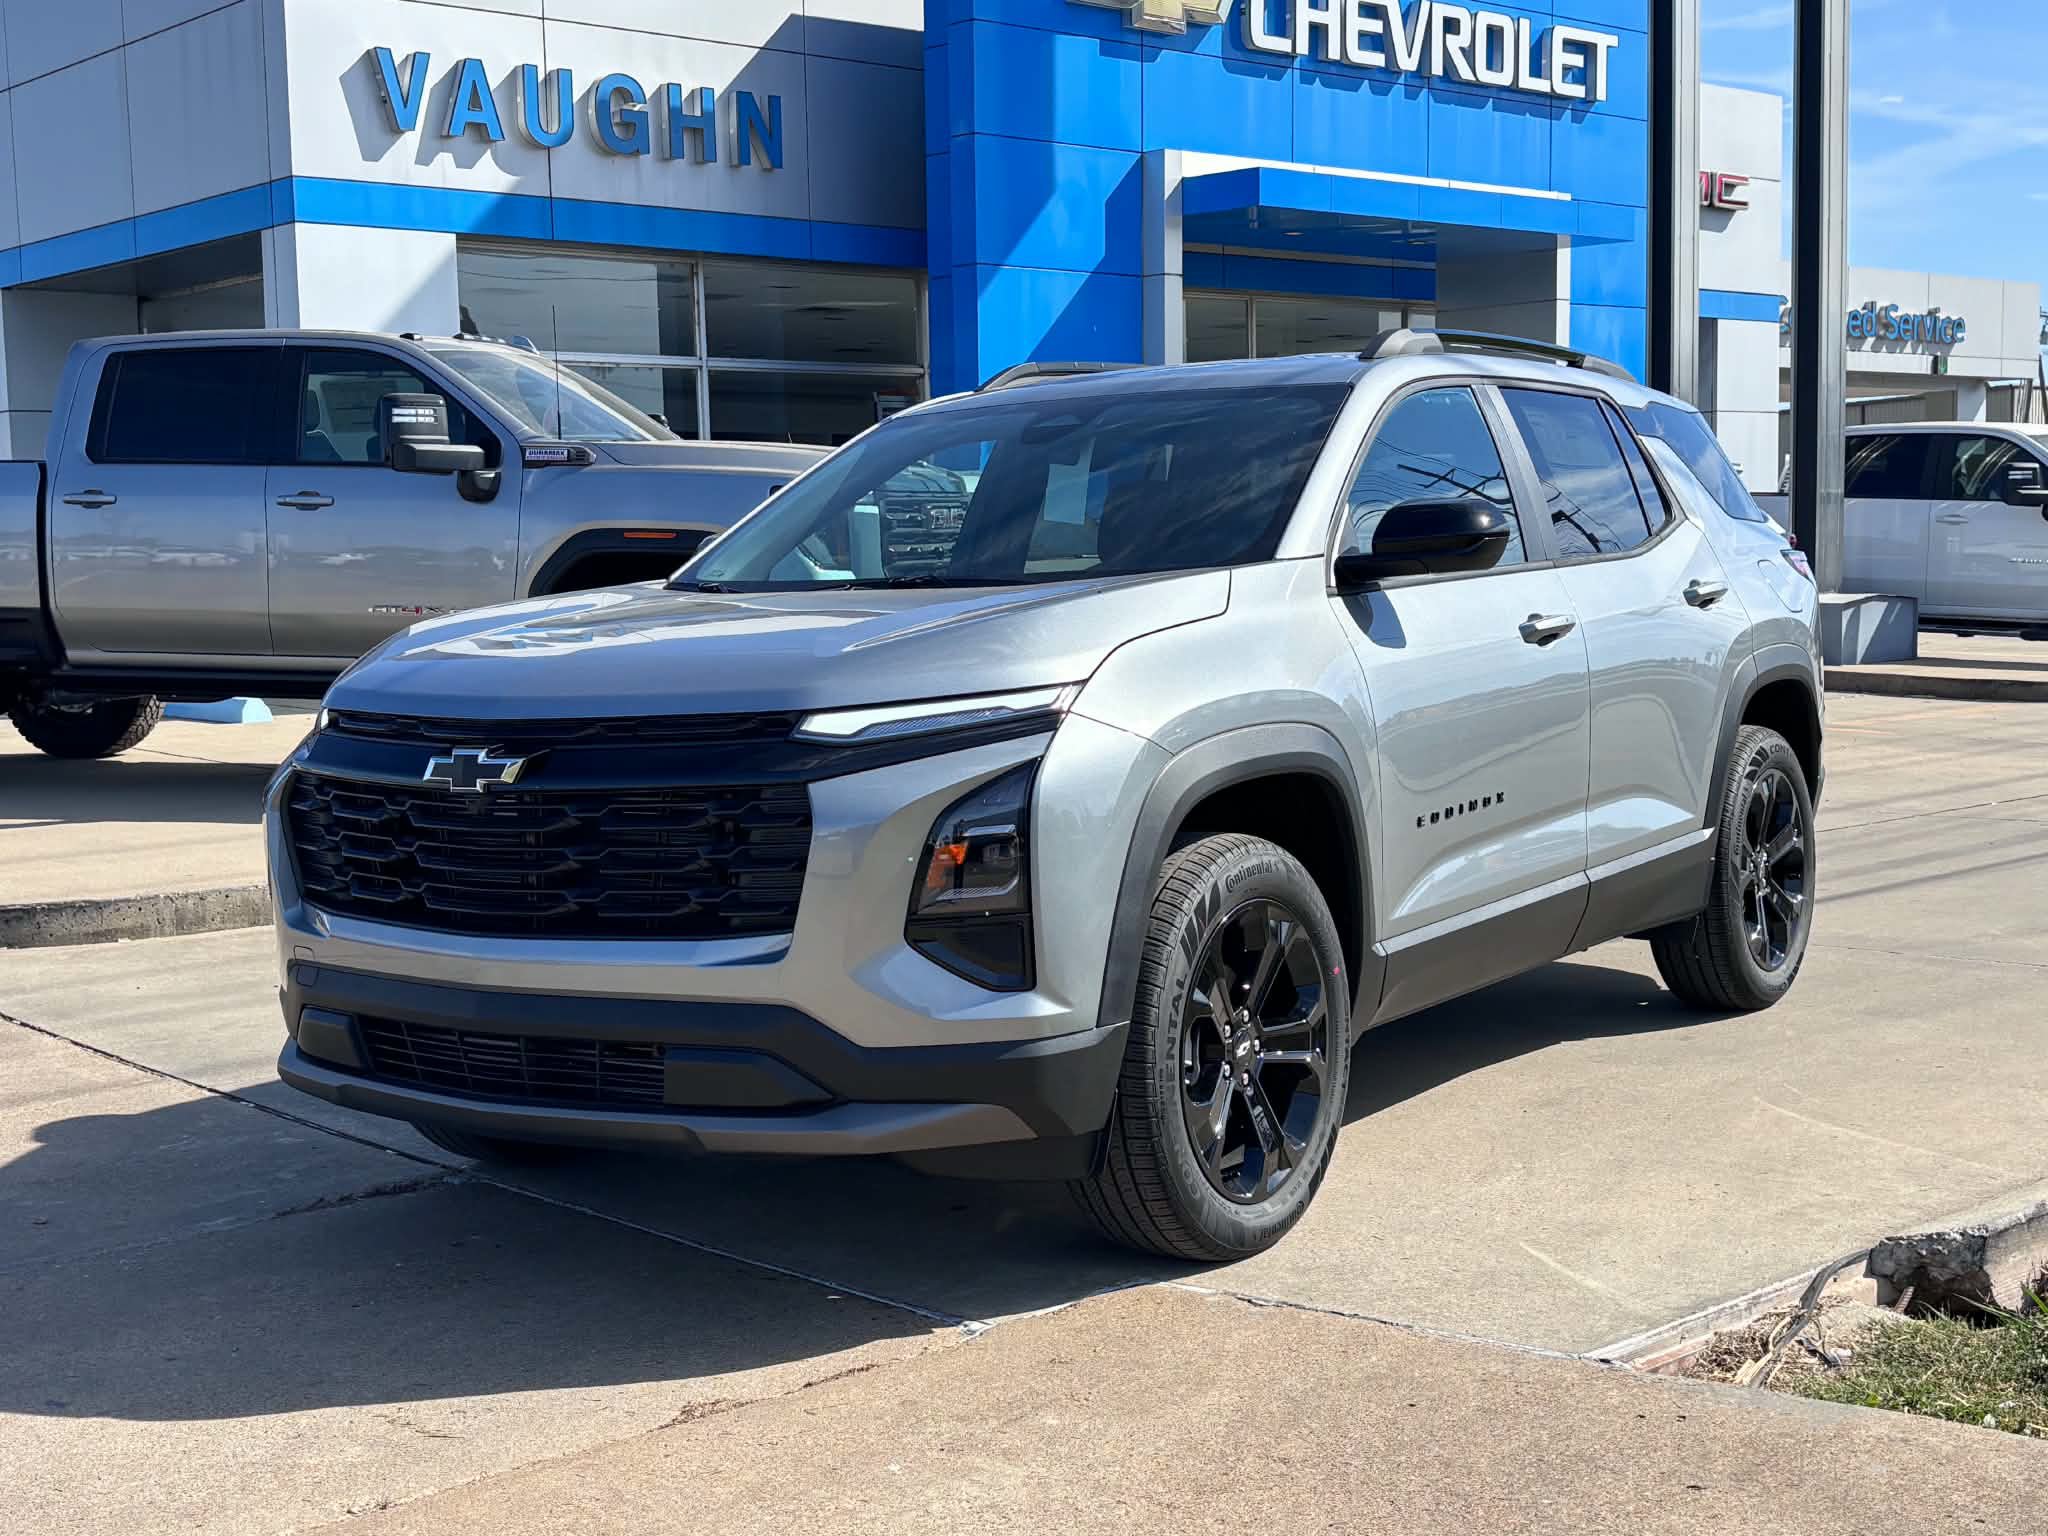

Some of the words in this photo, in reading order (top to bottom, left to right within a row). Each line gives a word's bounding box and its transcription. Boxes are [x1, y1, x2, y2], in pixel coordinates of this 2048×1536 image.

[1249, 0, 1619, 101] CHEVROLET
[372, 46, 783, 169] VAUGHN
[1885, 303, 1966, 344] Service
[1416, 791, 1505, 828] EQUINOX
